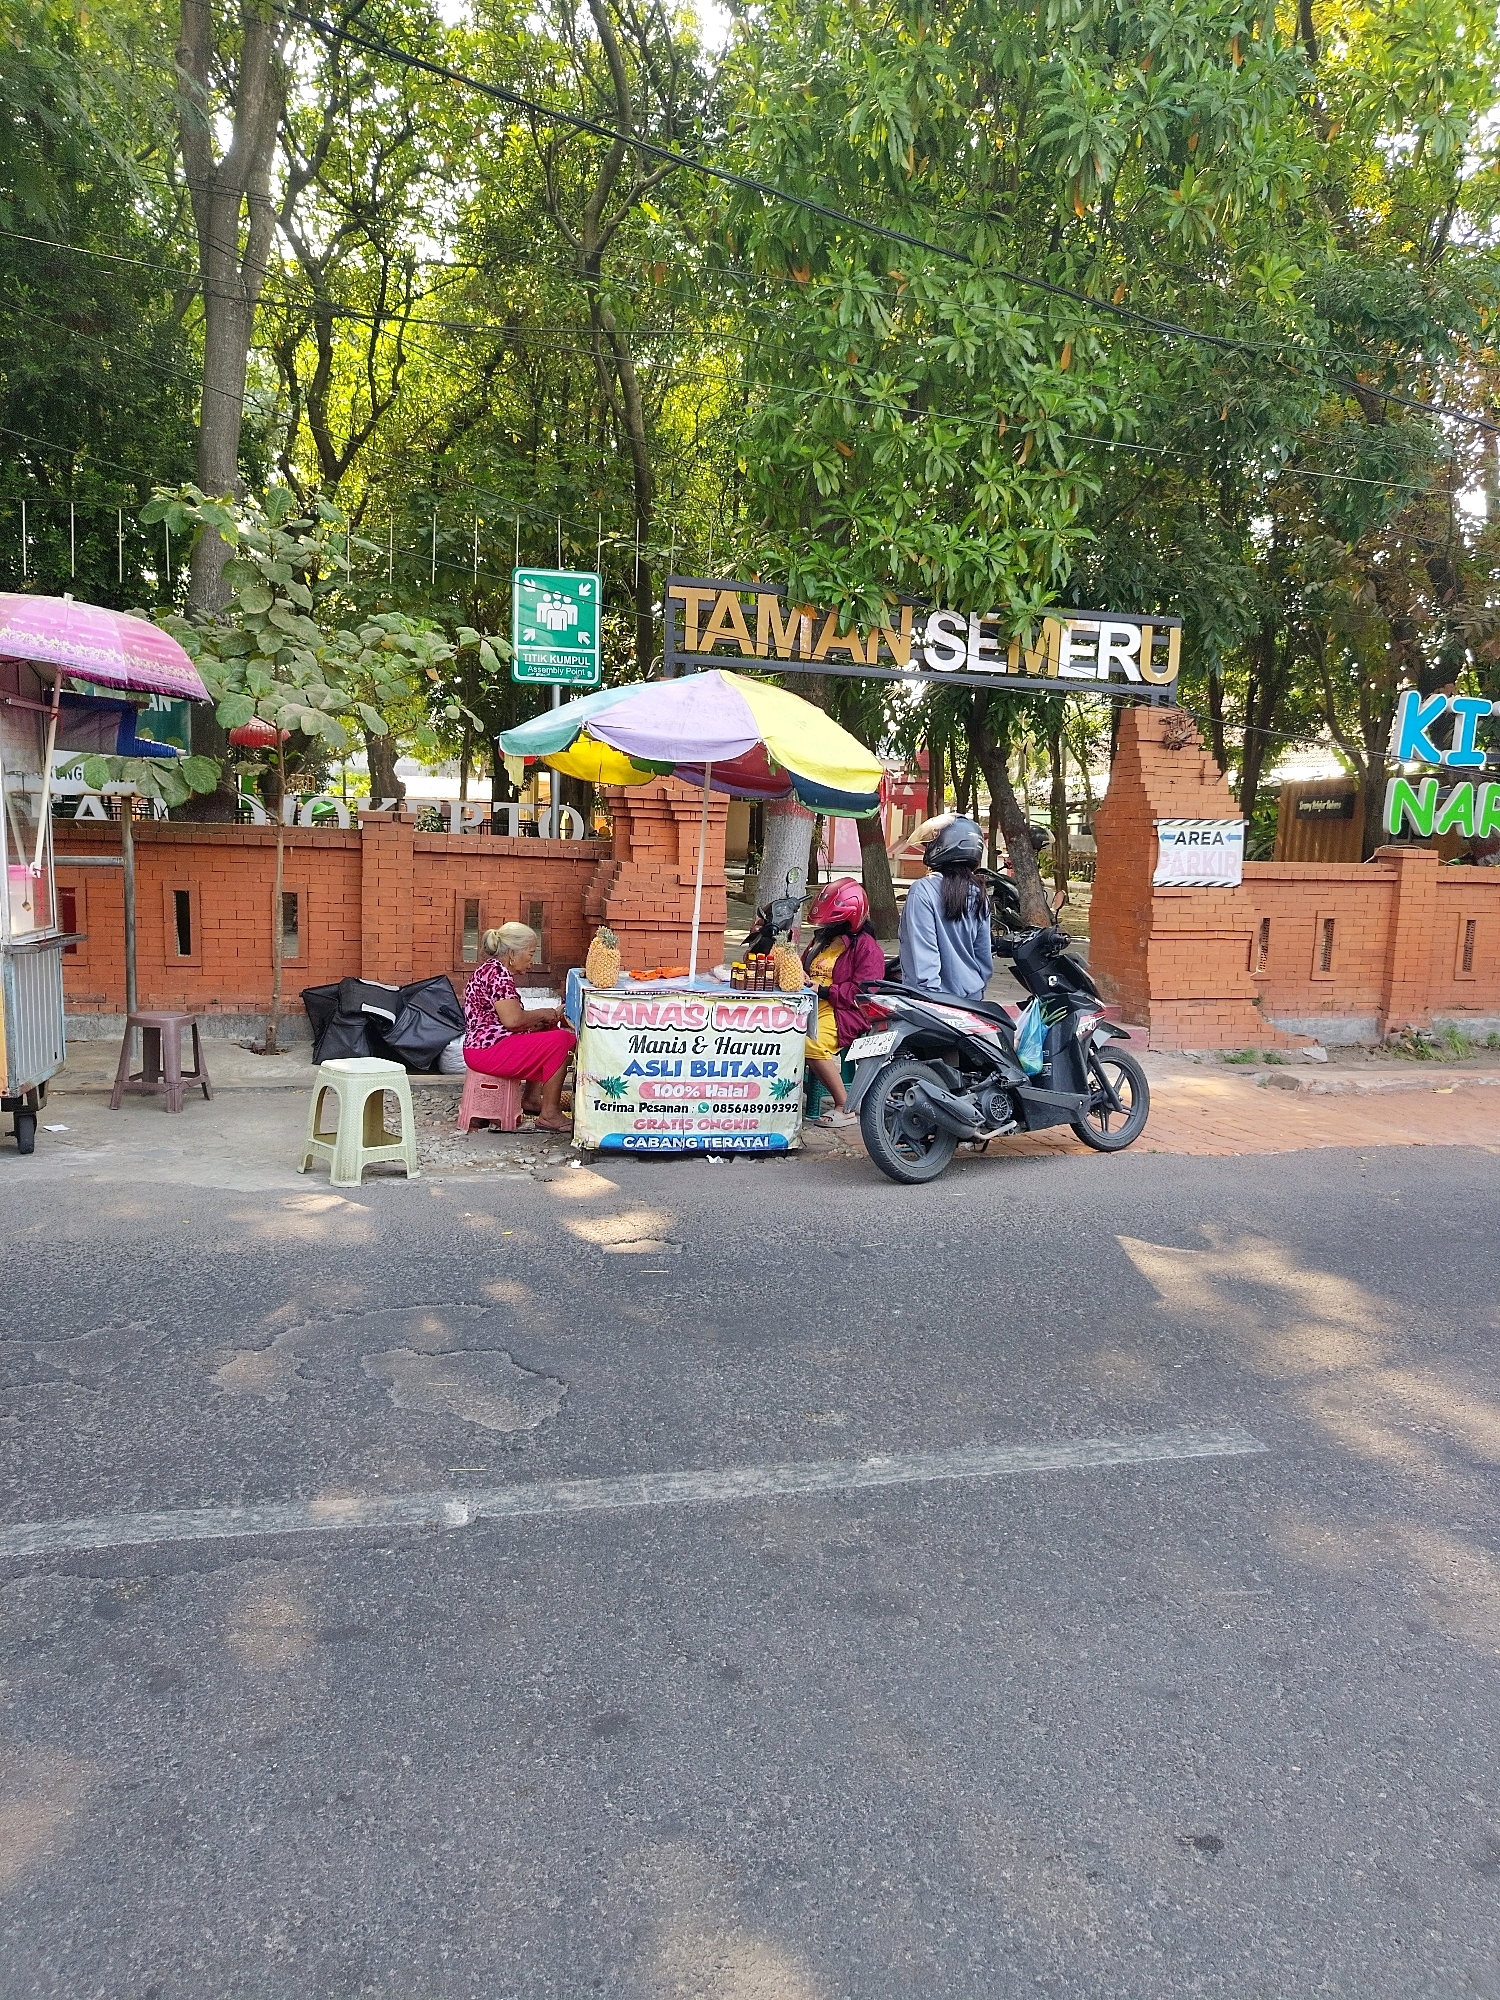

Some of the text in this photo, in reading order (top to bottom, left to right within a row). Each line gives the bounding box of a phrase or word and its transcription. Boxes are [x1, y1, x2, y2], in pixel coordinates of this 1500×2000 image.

[668, 586, 1182, 685] TAMAN SEMERU
[523, 653, 590, 666] TITIK KUMPUL
[527, 665, 585, 676] Assembly Point
[1391, 690, 1500, 767] KI
[1174, 831, 1225, 846] AREA
[1159, 850, 1239, 877] PARKIR
[586, 1001, 705, 1027] NANAS
[629, 1034, 781, 1056] Manis & Harum
[623, 1059, 779, 1079] ASLI BLITAR
[652, 1083, 749, 1098] 100% Halal
[594, 1099, 634, 1113] Terima
[639, 1102, 688, 1113] Pesanan
[712, 1103, 799, 1114] 085648909392
[633, 1118, 759, 1131] GRATIS ONGKIR
[623, 1136, 770, 1149] CABANG TERATAI
